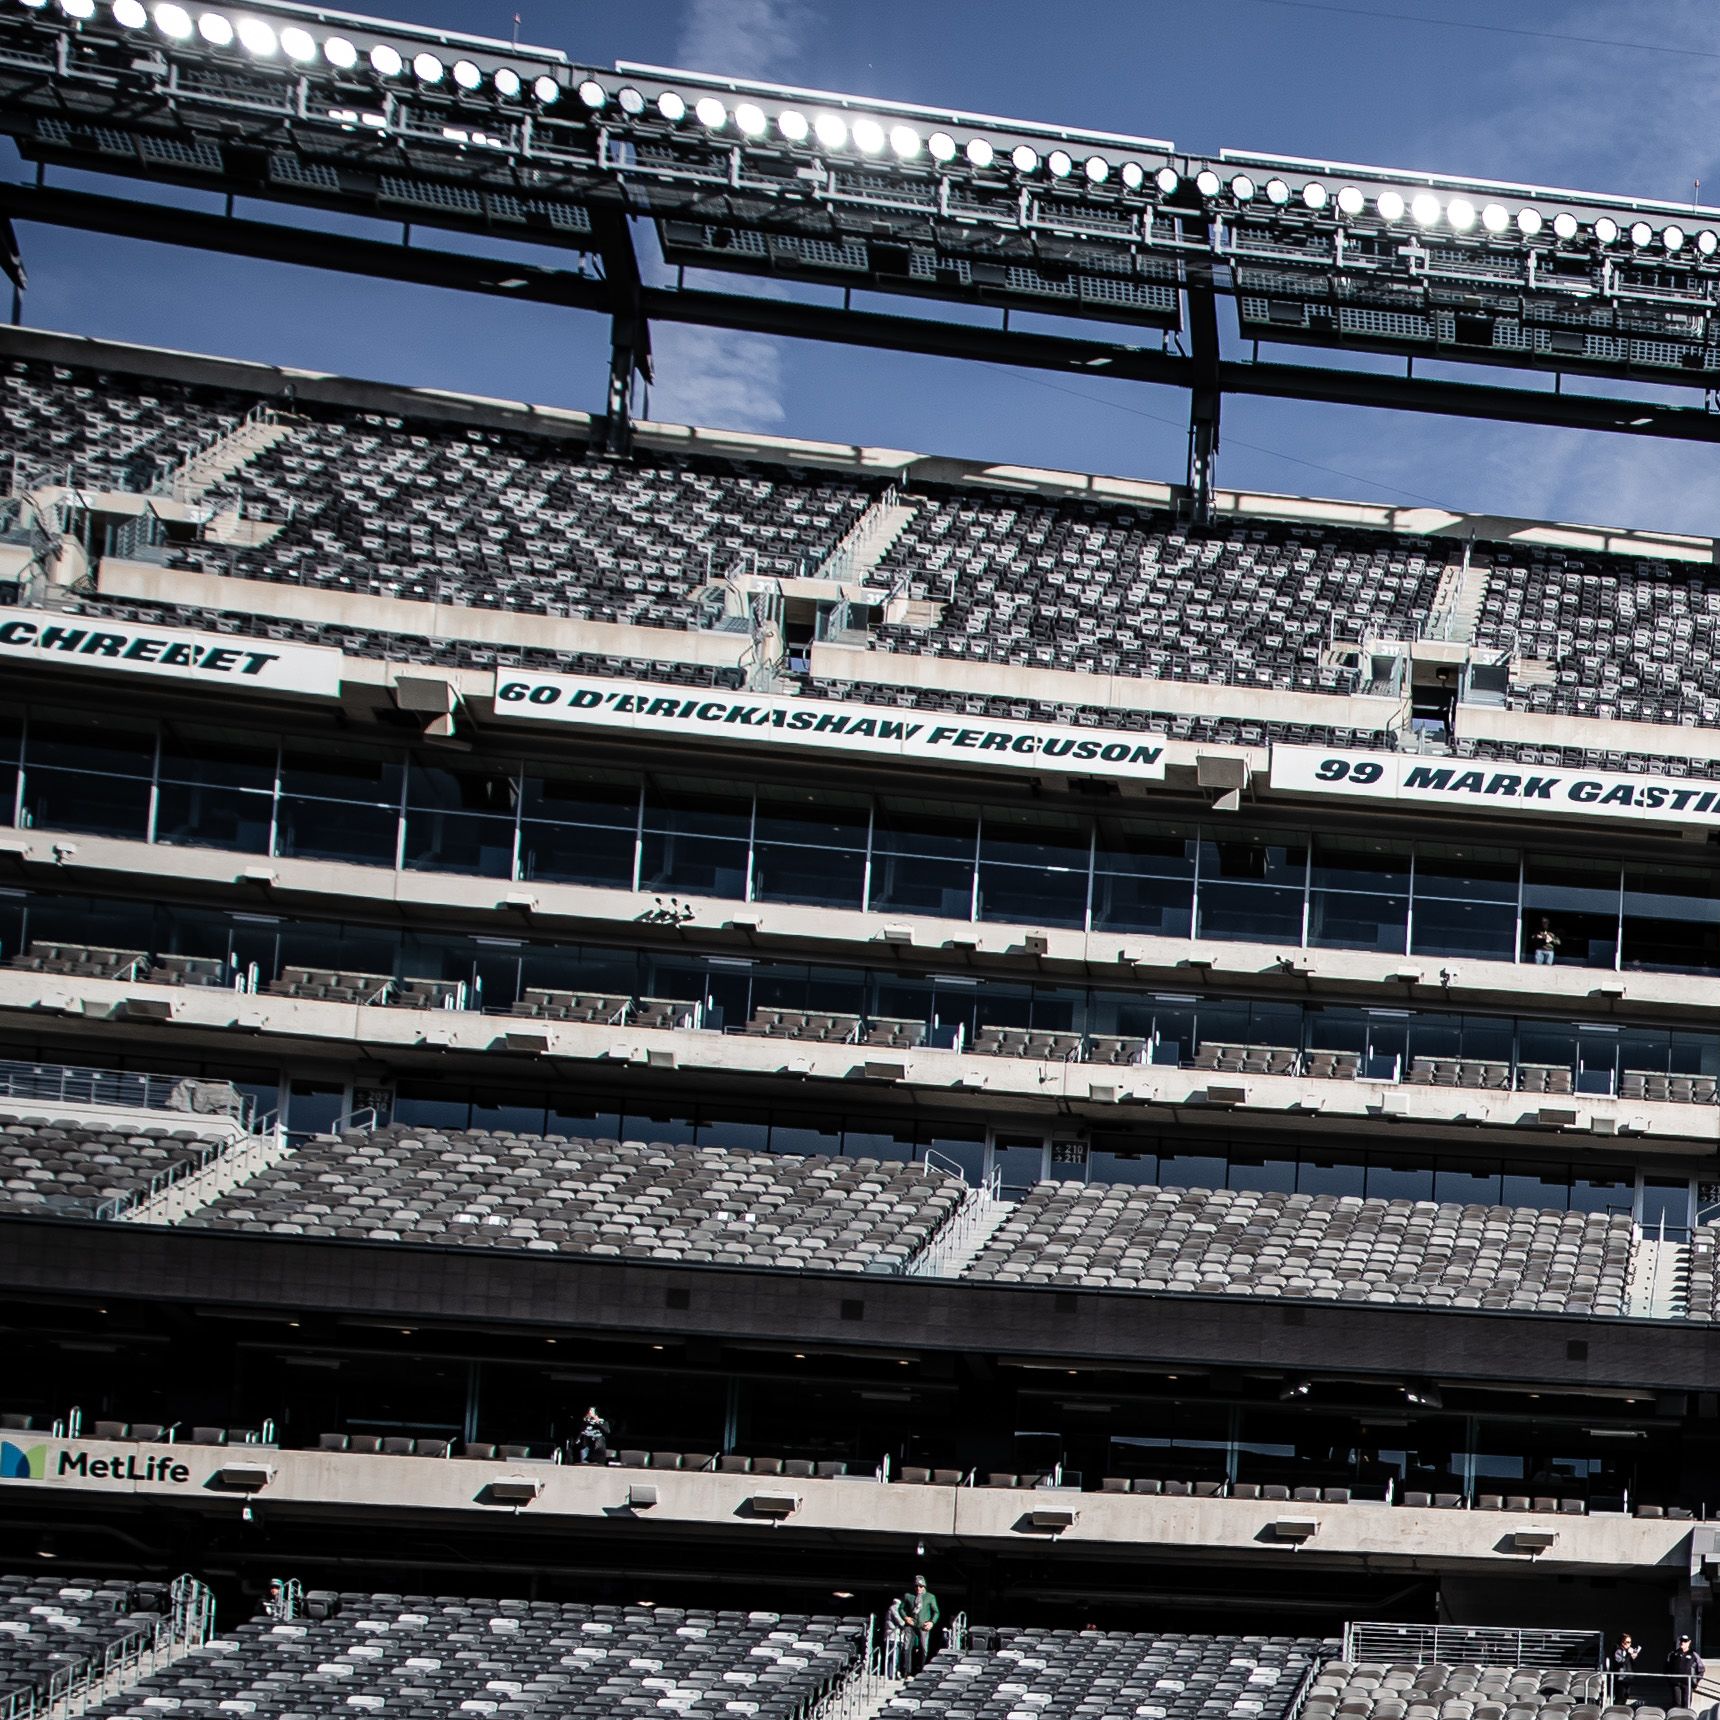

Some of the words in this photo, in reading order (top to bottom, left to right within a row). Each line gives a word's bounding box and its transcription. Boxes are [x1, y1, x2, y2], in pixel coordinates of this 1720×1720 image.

[0, 621, 281, 675] CHREBET
[497, 681, 562, 705] 60
[567, 688, 924, 741] D'BRICKASHAW
[926, 725, 1164, 765] FERGUSON
[1314, 758, 1384, 785] 99
[1402, 766, 1563, 799] MARK
[57, 1450, 190, 1483] MetLife
